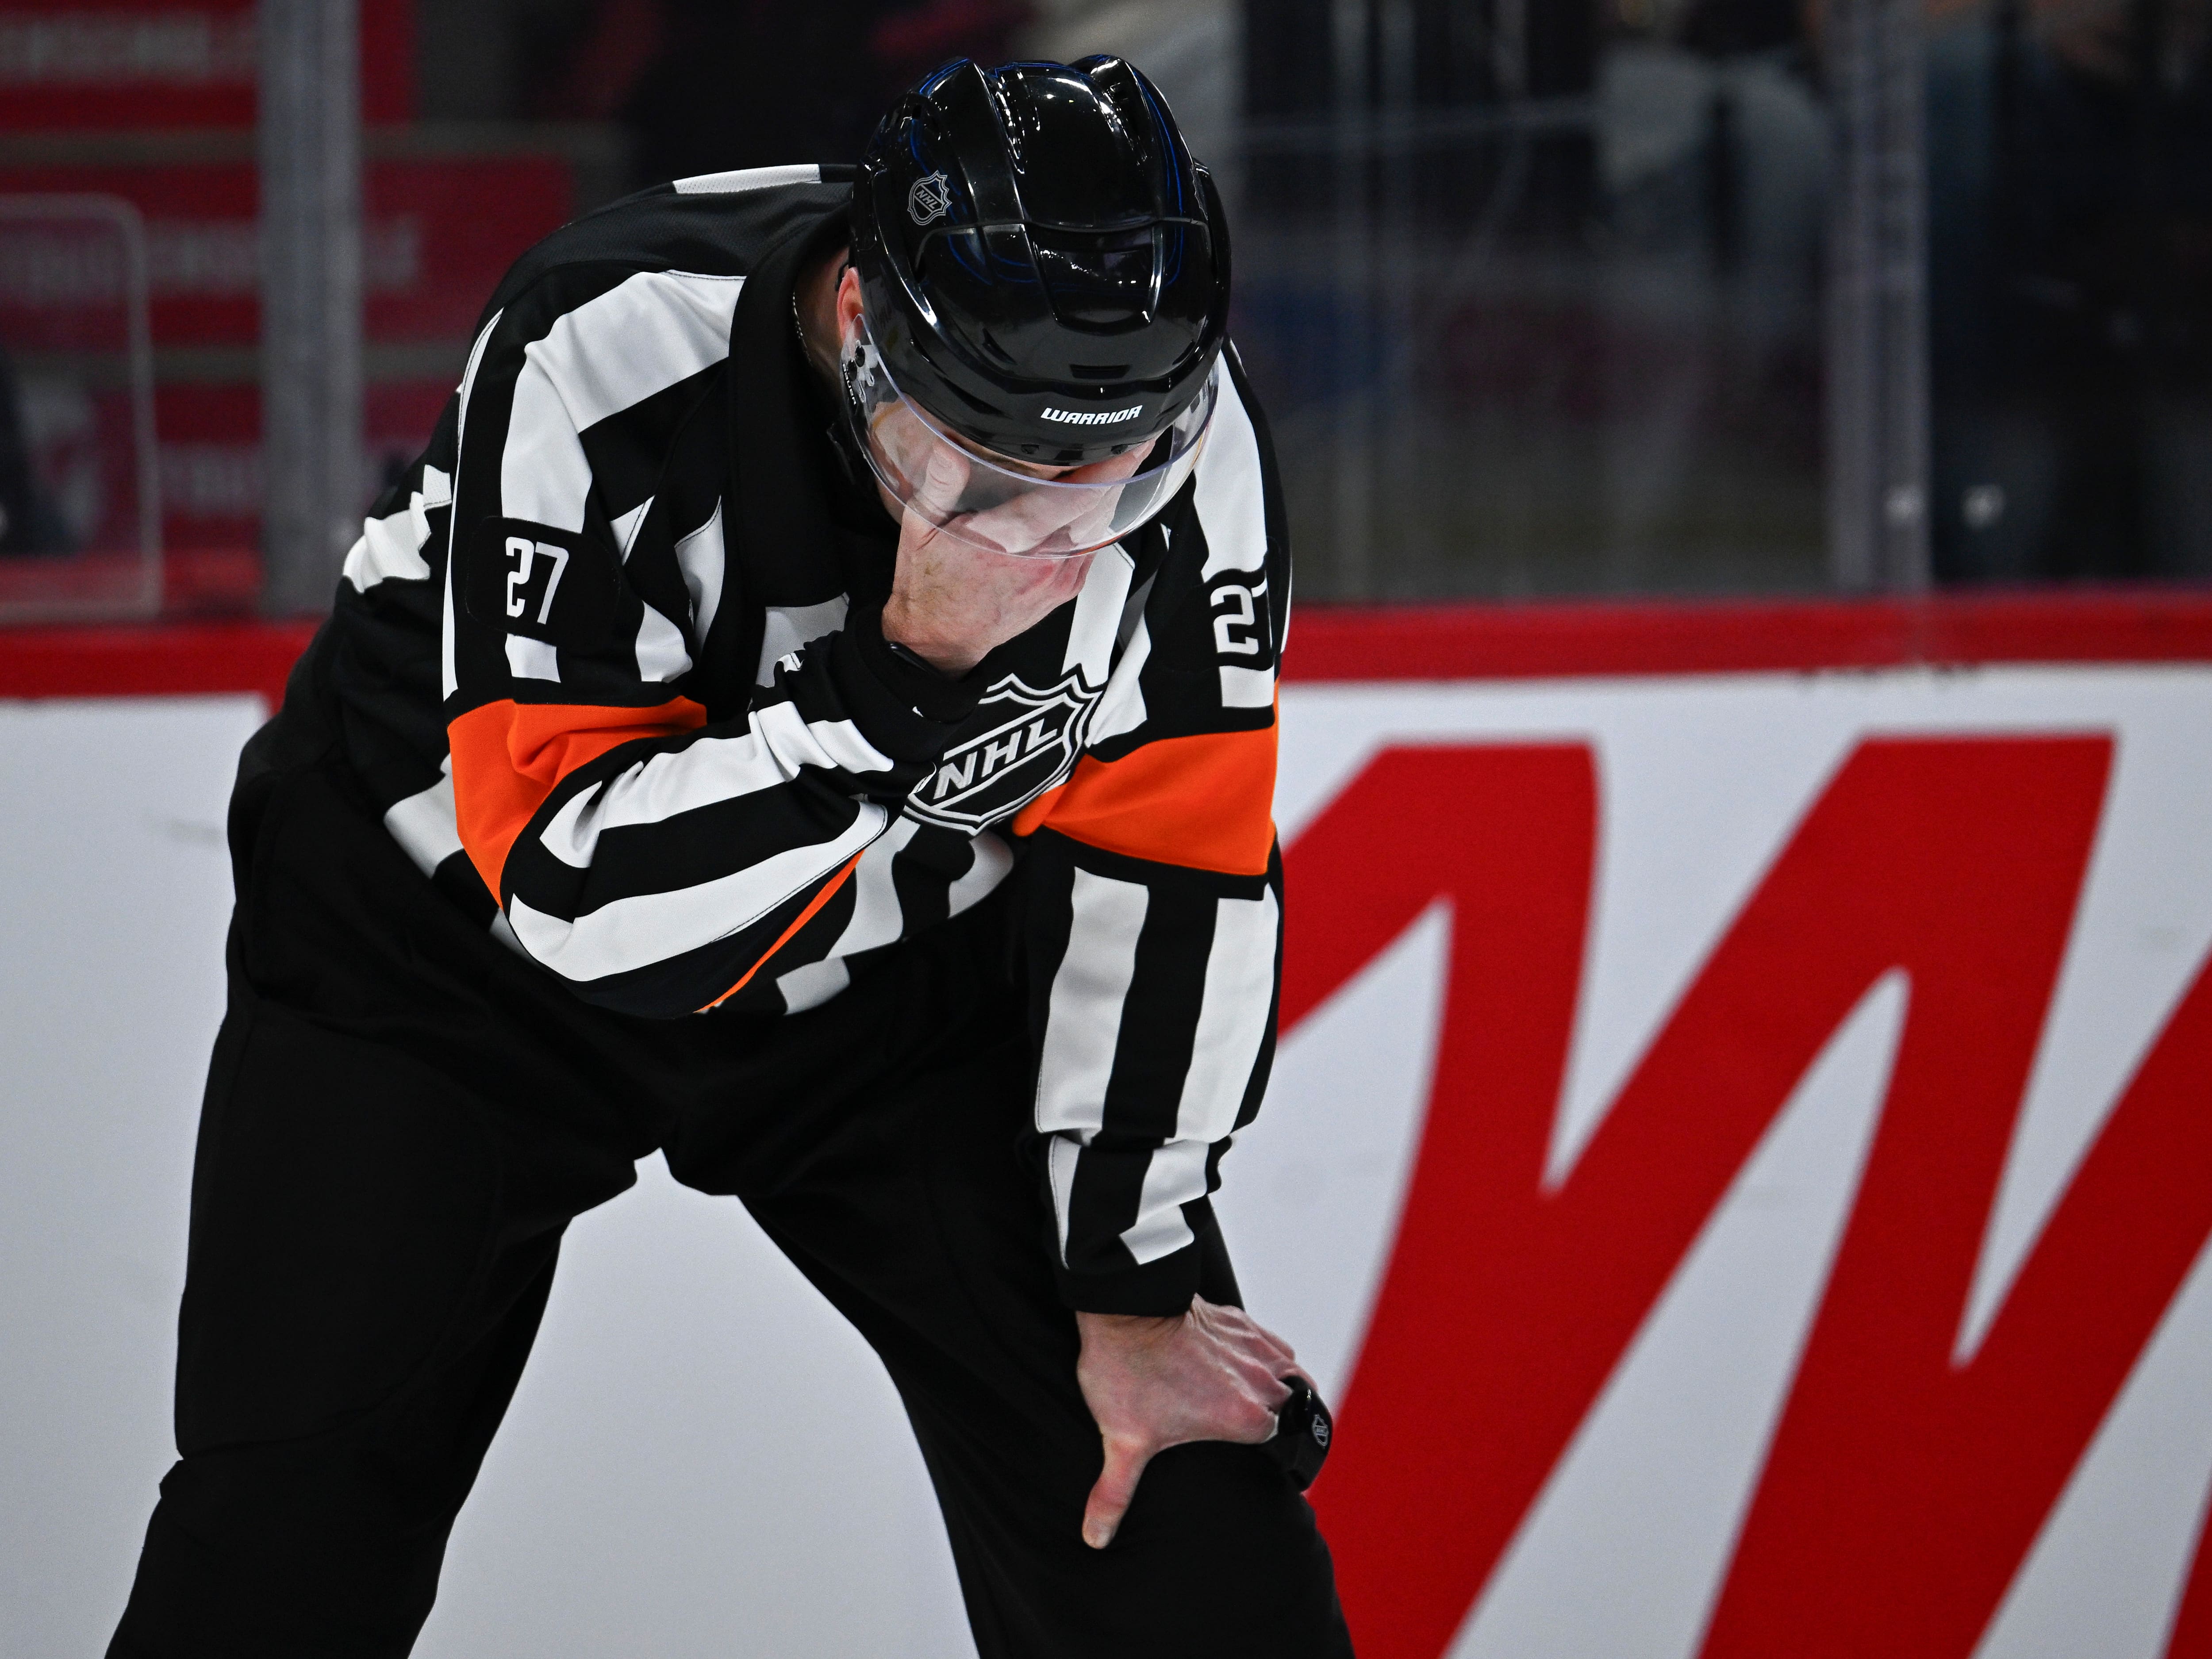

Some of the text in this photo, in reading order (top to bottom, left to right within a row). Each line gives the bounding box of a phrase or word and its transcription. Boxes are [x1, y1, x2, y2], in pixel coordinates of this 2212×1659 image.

[916, 190, 938, 209] NHL
[1041, 405, 1143, 425] WARRIOR
[506, 536, 569, 625] 27
[933, 718, 1058, 799] NHL
